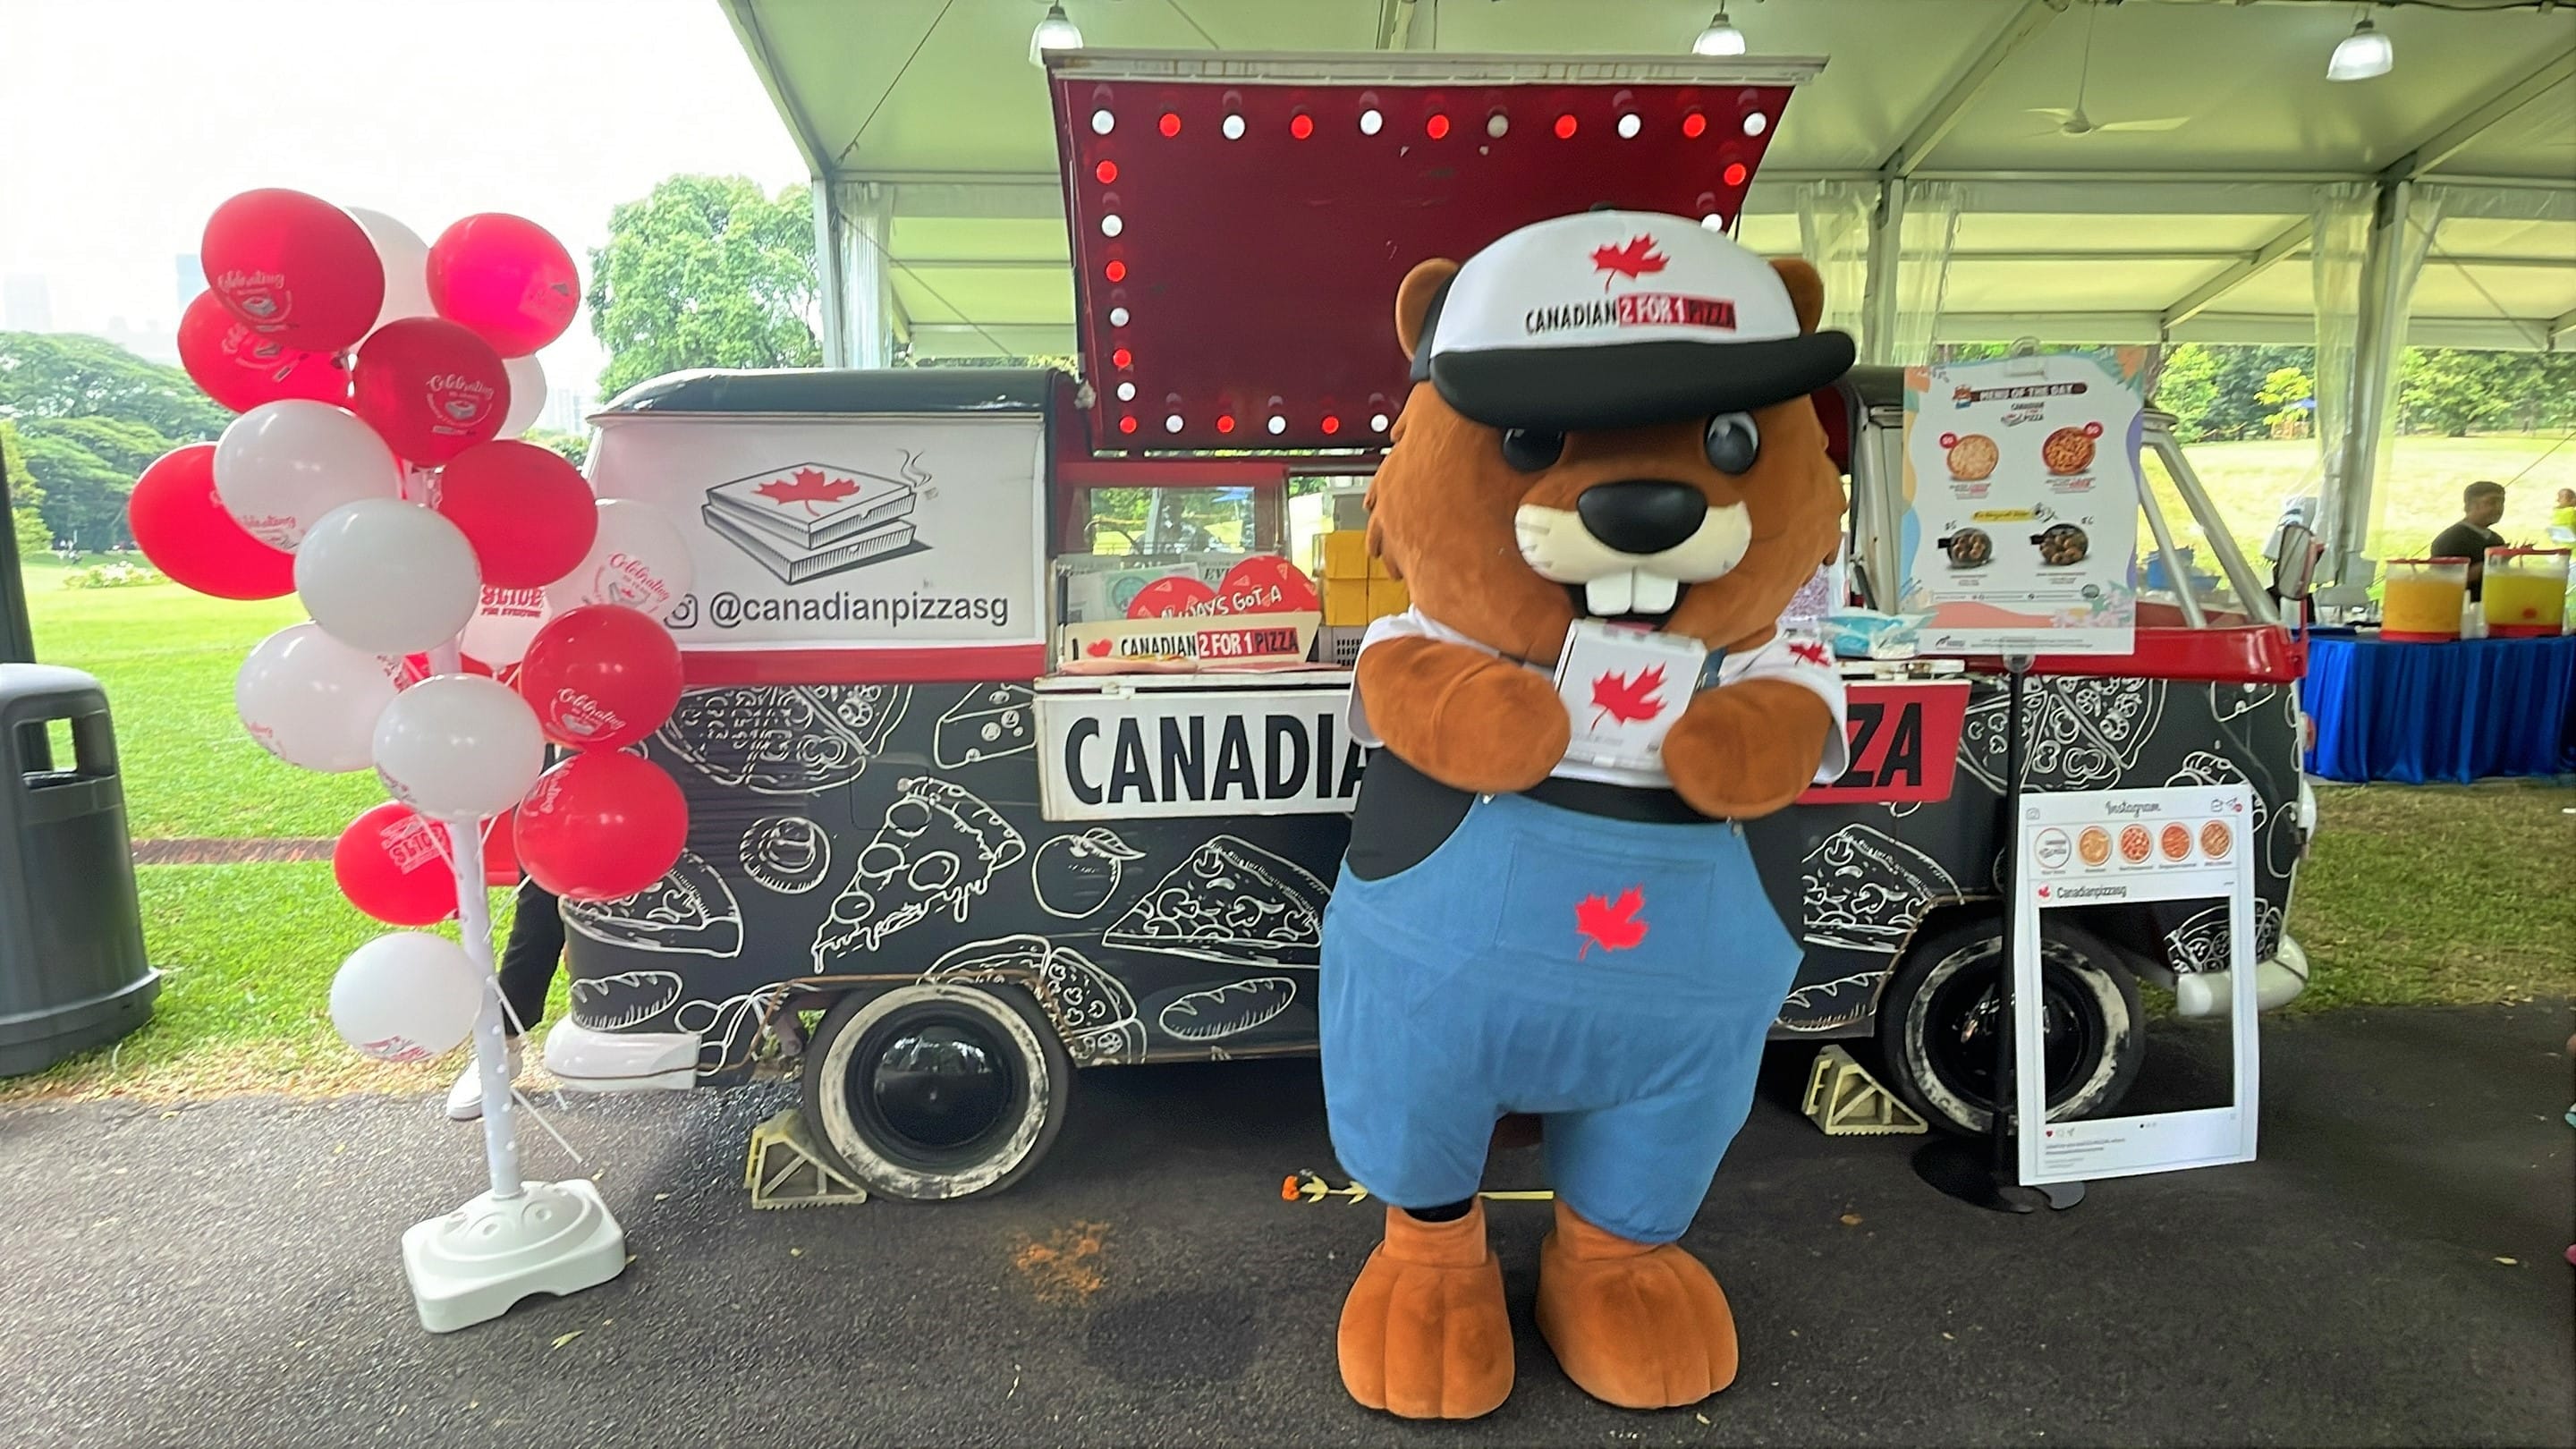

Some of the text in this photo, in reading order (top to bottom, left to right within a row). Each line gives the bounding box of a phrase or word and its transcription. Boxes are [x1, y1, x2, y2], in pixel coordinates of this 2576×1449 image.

[1525, 300, 1617, 335] CANADIAN
[1620, 297, 1634, 322] 2
[1636, 294, 1673, 324] FOR
[1674, 295, 1685, 323] 1
[426, 374, 494, 401] Celebrating
[609, 553, 670, 603] Celebrating
[1270, 584, 1283, 603] A
[709, 590, 1009, 629] @canadianpizzasg
[1072, 630, 1299, 661] I CANADIAN 2 FOR 1 PIZZA
[557, 688, 627, 731] Celebrating
[1064, 713, 1370, 805] CANADIA
[2105, 801, 2162, 818] Instagram
